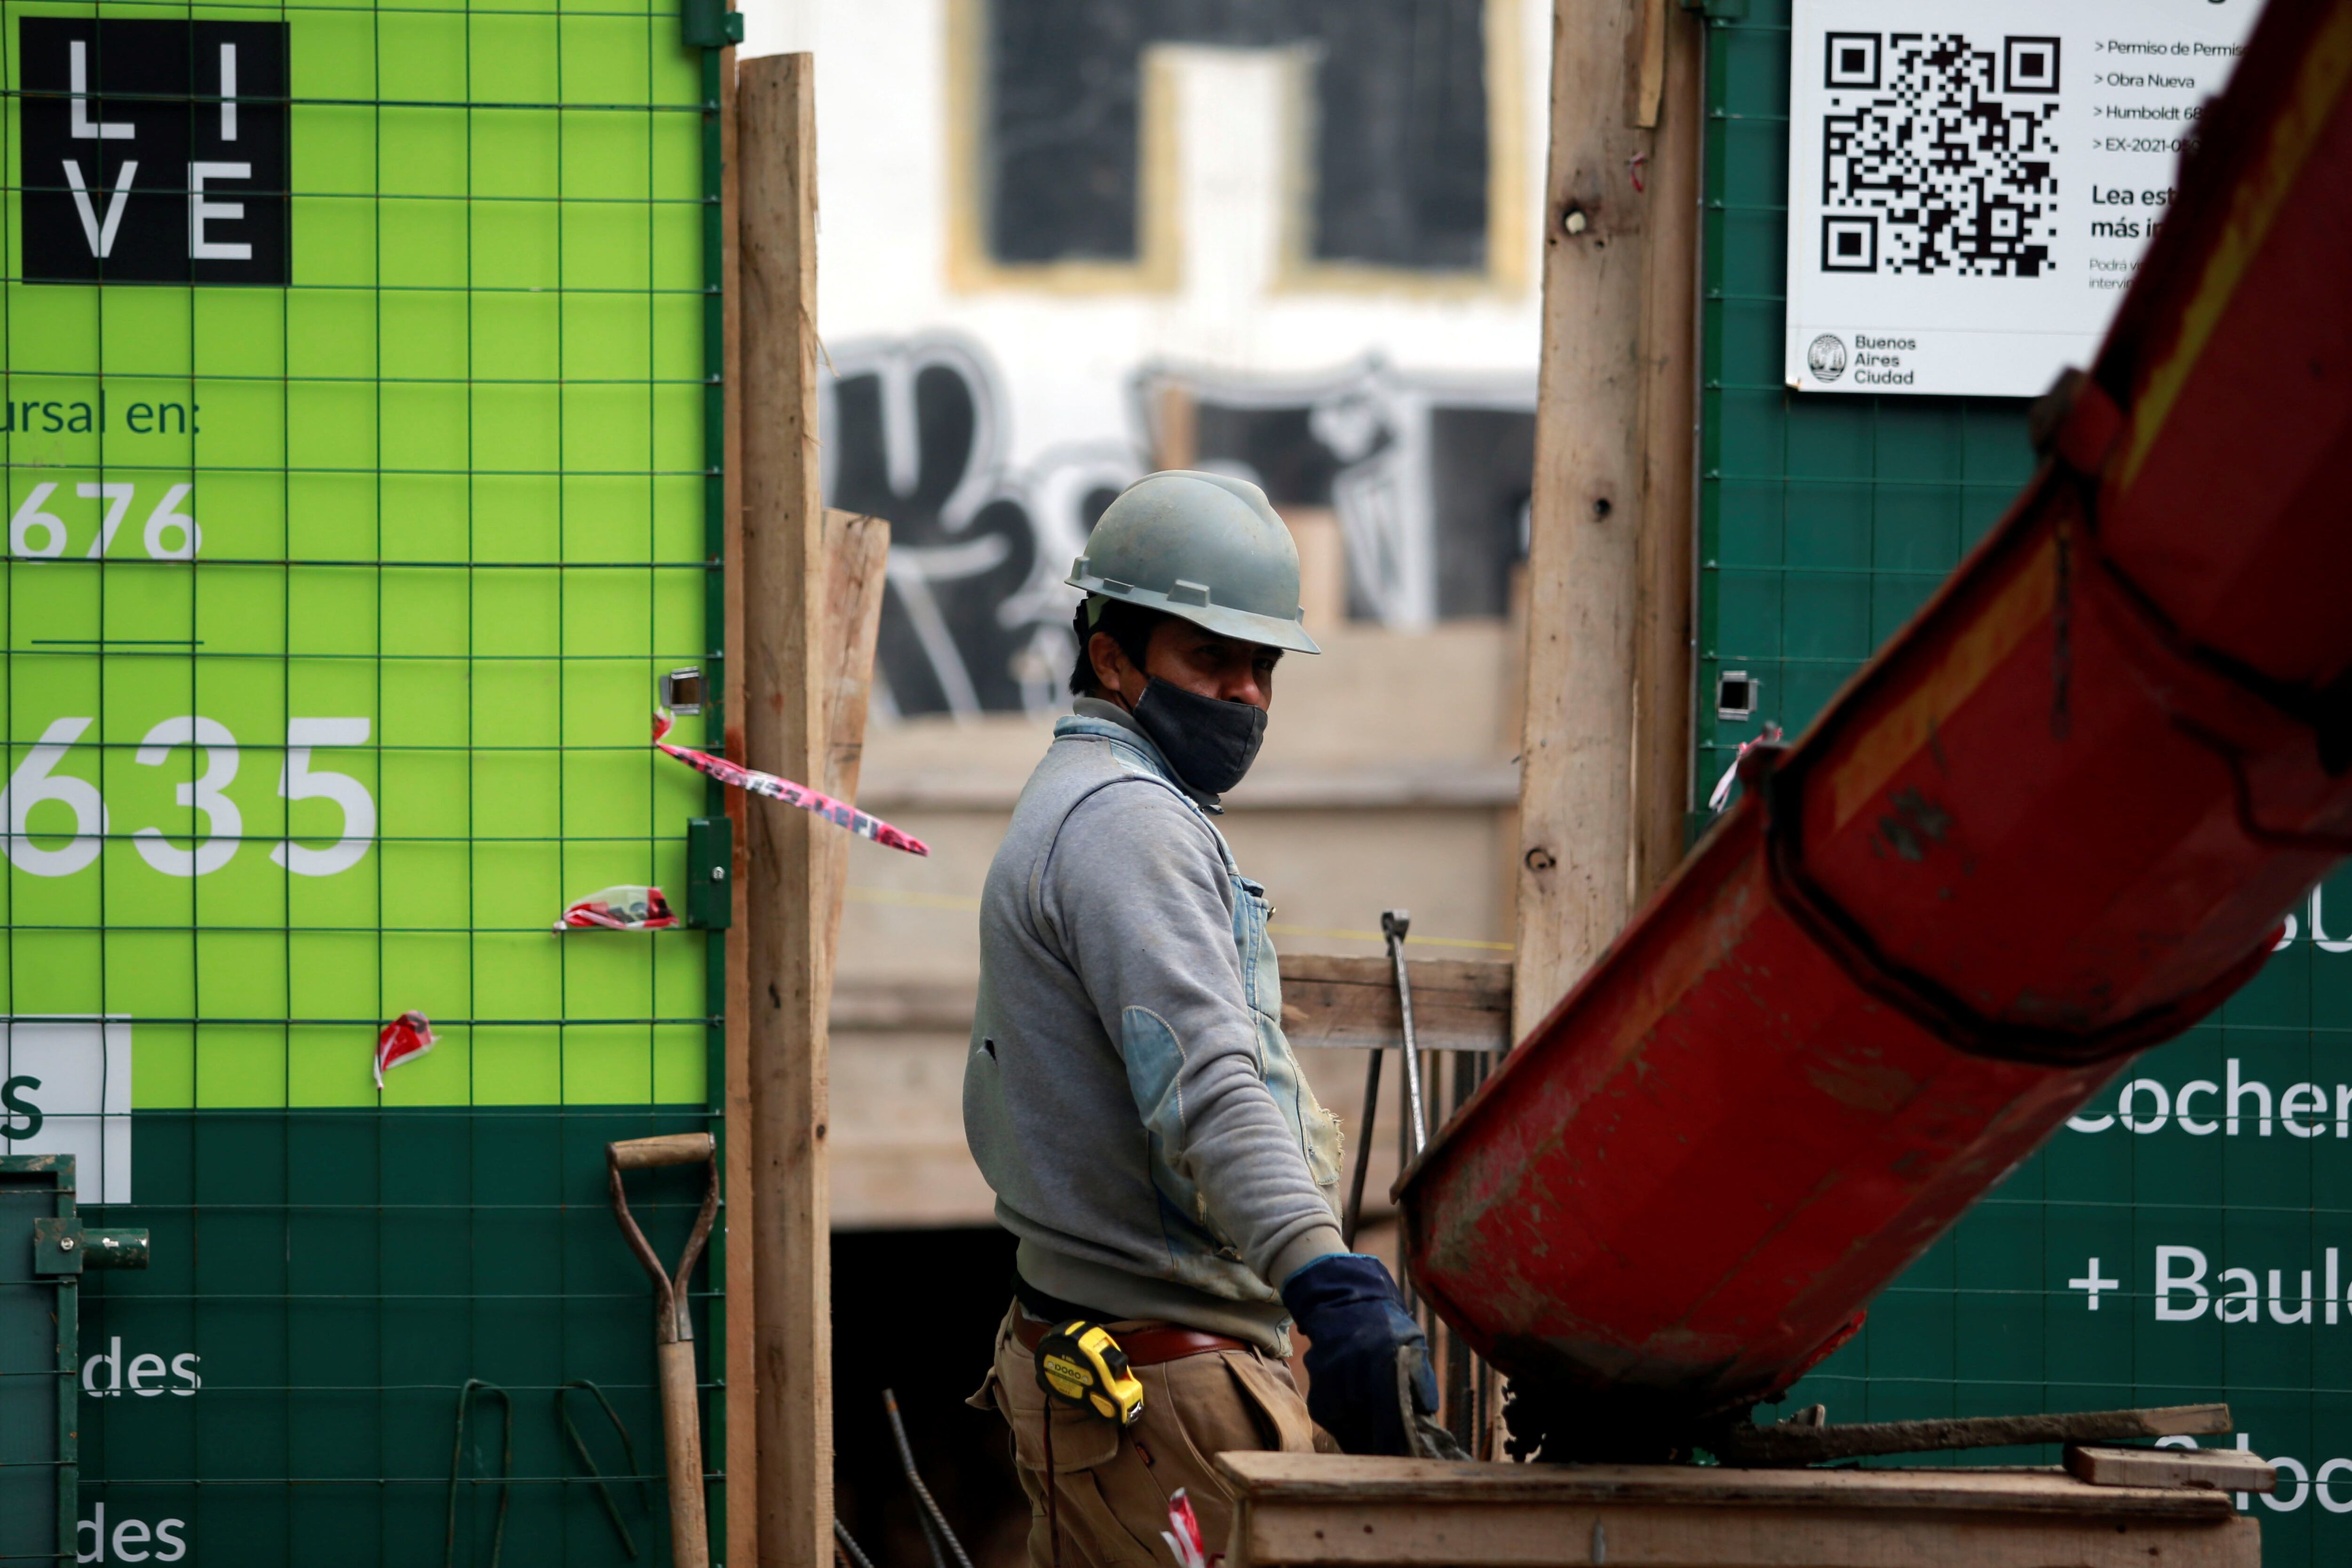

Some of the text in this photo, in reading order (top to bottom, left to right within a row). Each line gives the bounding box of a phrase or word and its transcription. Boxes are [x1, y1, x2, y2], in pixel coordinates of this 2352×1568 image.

[2107, 40, 2167, 56] Permiso
[2170, 41, 2190, 56] de
[2107, 72, 2195, 89] Obra Nueva
[2106, 105, 2179, 121] Humboldt
[2092, 184, 2134, 205] Lea
[2091, 216, 2139, 238] más
[1855, 334, 1916, 350] Buenos
[1855, 353, 1900, 367] Aires
[1854, 370, 1914, 384] Ciudad
[126, 401, 201, 434] en:
[9, 483, 202, 565] 676
[0, 715, 376, 877] 635
[2155, 1245, 2352, 1325] Baul
